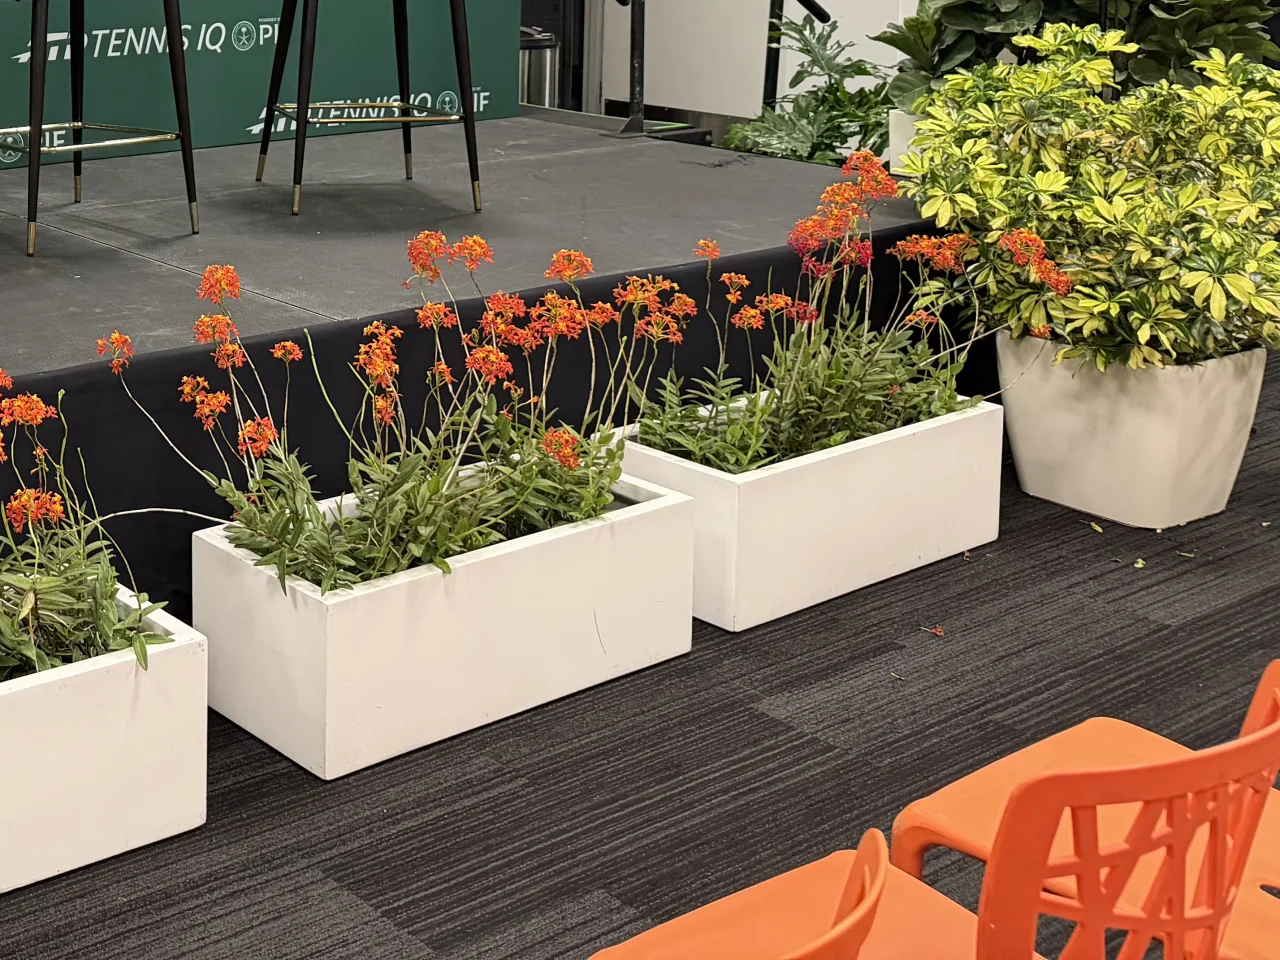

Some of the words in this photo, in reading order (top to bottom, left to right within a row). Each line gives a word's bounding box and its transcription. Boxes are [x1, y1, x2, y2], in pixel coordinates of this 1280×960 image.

[92, 25, 191, 58] TENNS
[197, 22, 226, 53] IQ
[259, 24, 279, 45] PI
[473, 92, 490, 112] IF
[41, 130, 66, 147] IF
